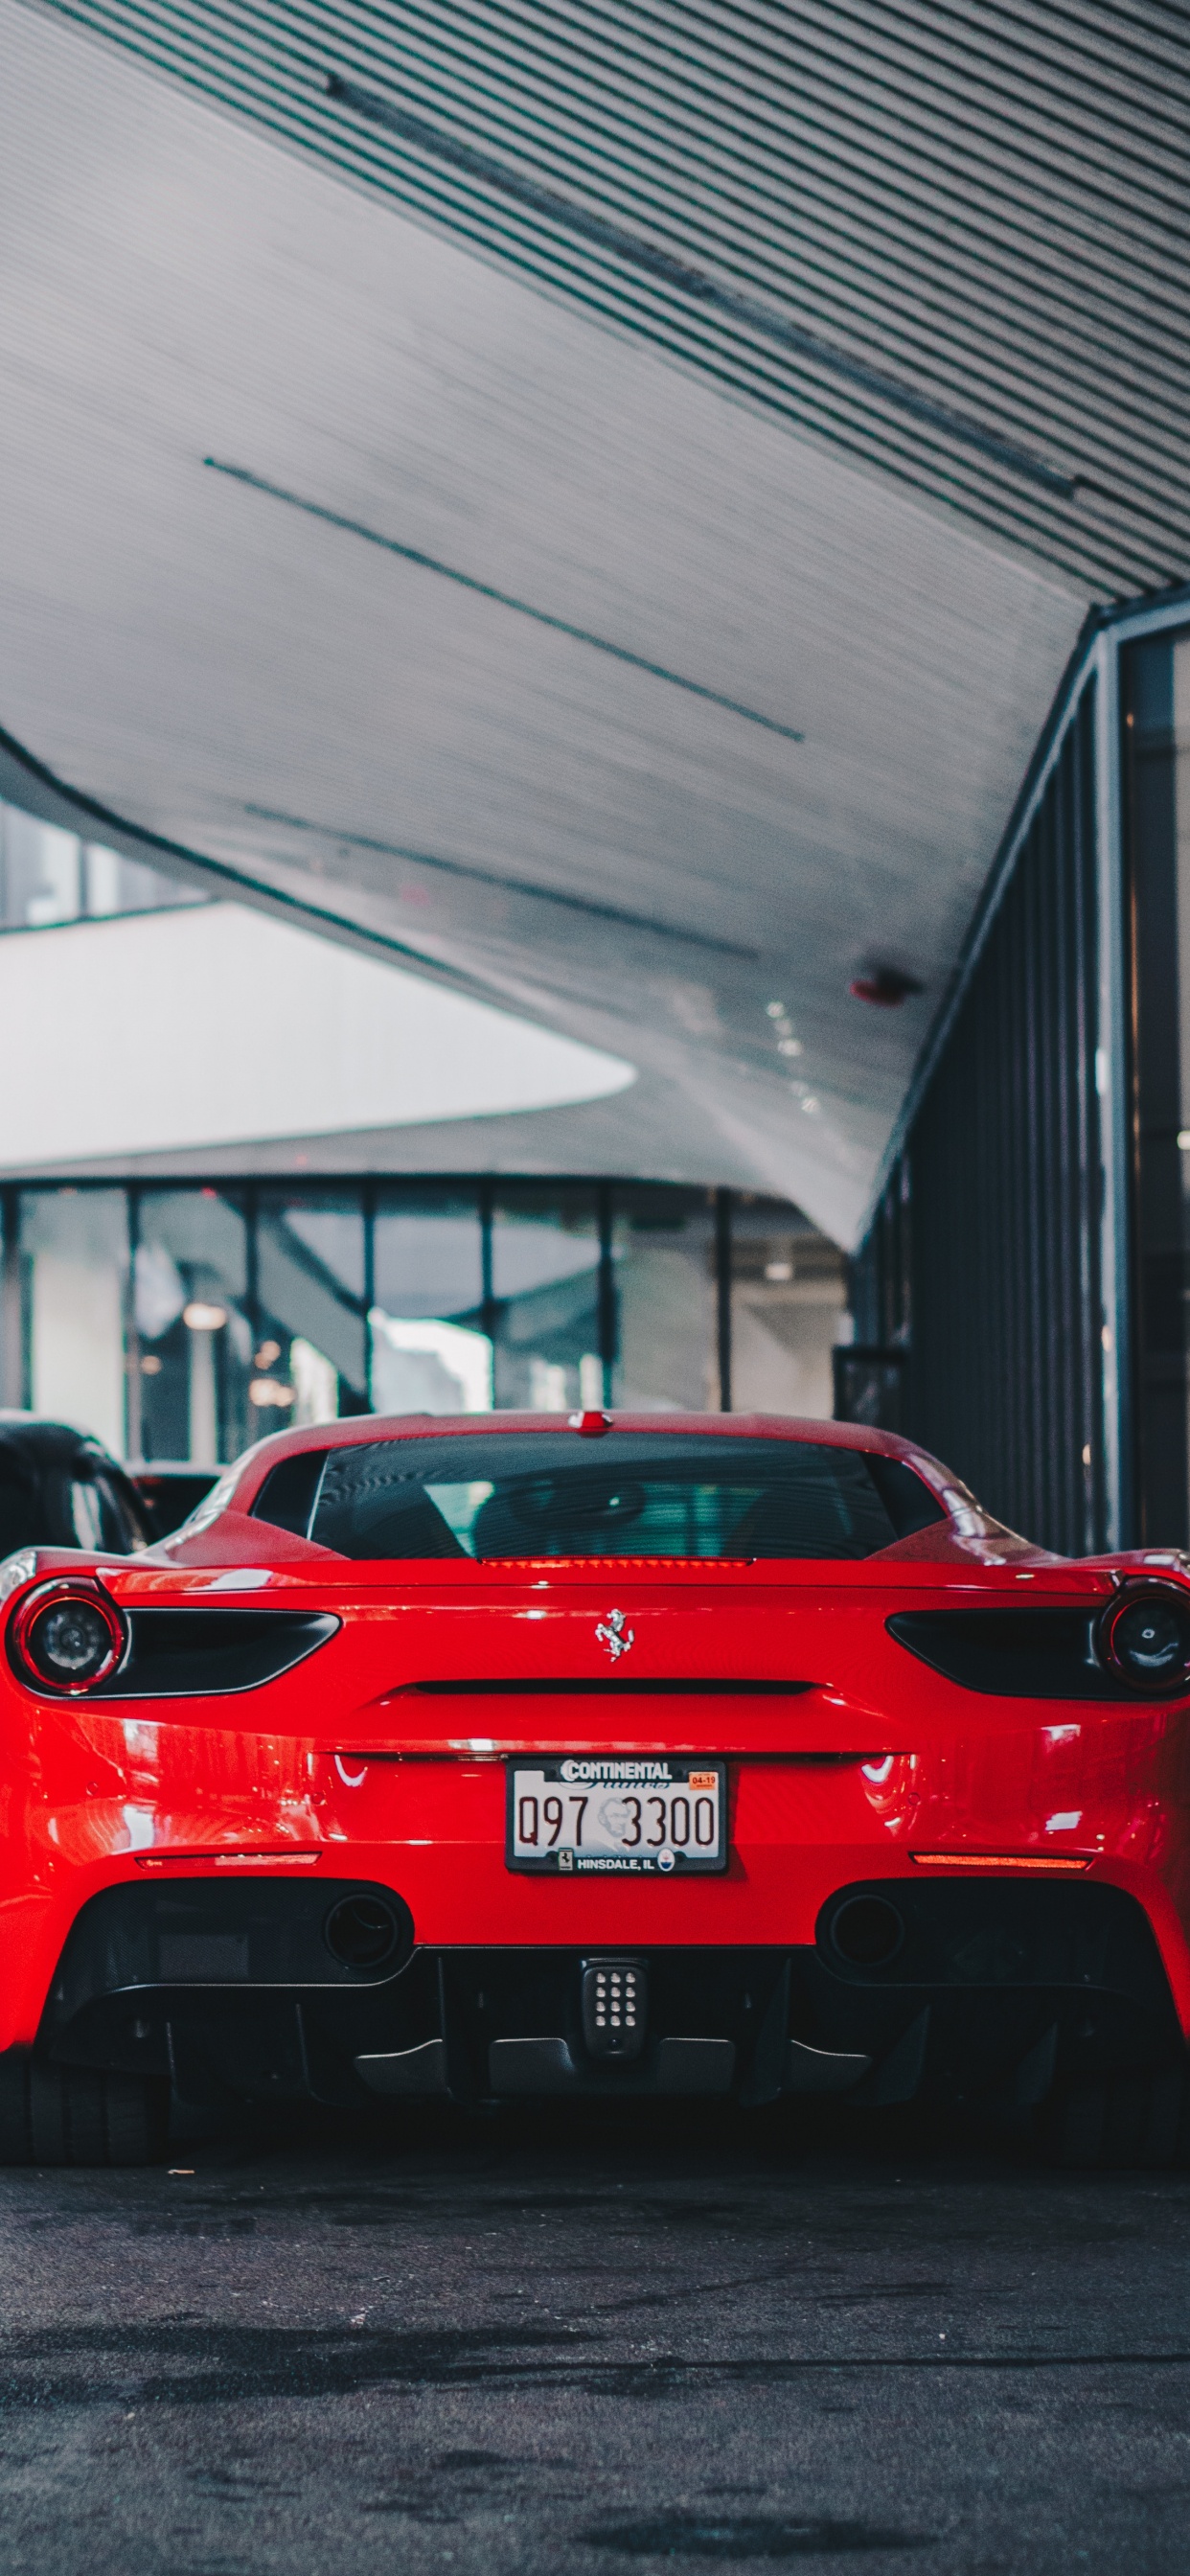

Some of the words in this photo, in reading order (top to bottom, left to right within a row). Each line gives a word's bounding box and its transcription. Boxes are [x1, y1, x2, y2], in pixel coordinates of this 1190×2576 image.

[561, 1760, 673, 1782] CONTINENTAL
[693, 1776, 716, 1784] 04-19
[518, 1796, 588, 1846] Q97
[622, 1796, 714, 1846] 3300
[578, 1859, 641, 1871] HINSDALE,
[643, 1860, 654, 1870] IL
